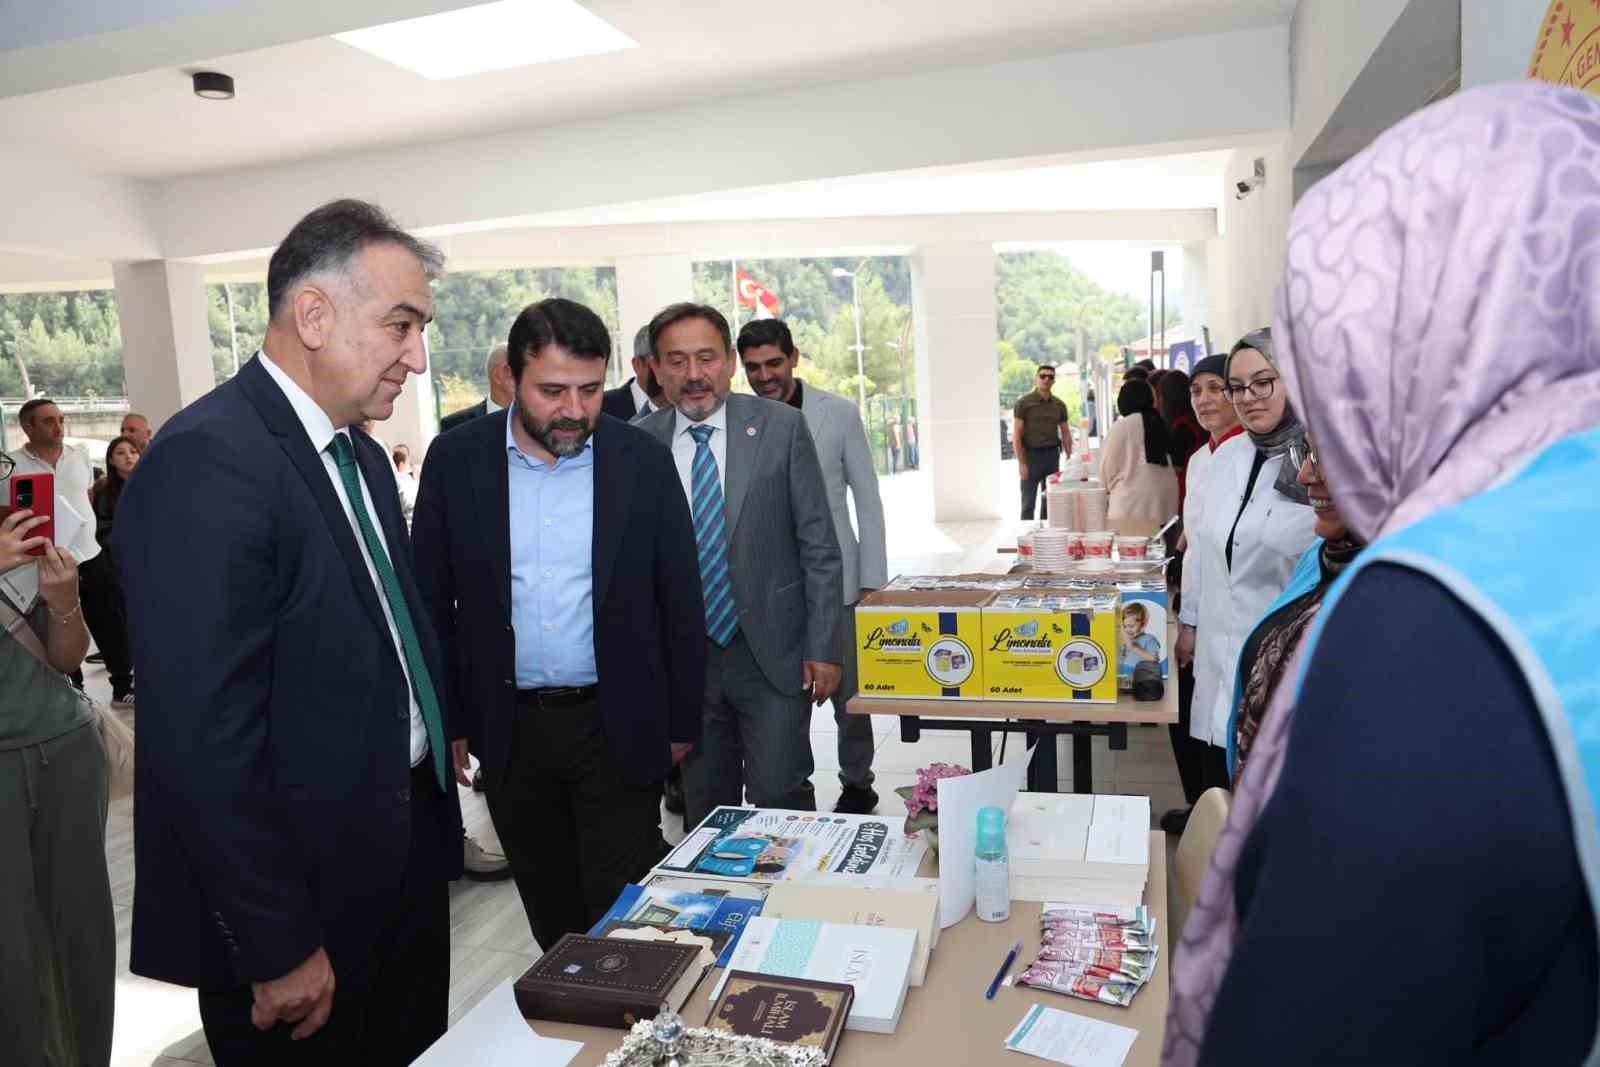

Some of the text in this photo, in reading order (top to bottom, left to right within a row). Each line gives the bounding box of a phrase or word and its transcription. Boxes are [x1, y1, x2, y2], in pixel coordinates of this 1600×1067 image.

[863, 626, 922, 651] Limonata
[988, 627, 1052, 652] Limonata
[864, 683, 896, 691] 60 Adet
[1002, 685, 1023, 694] Adet
